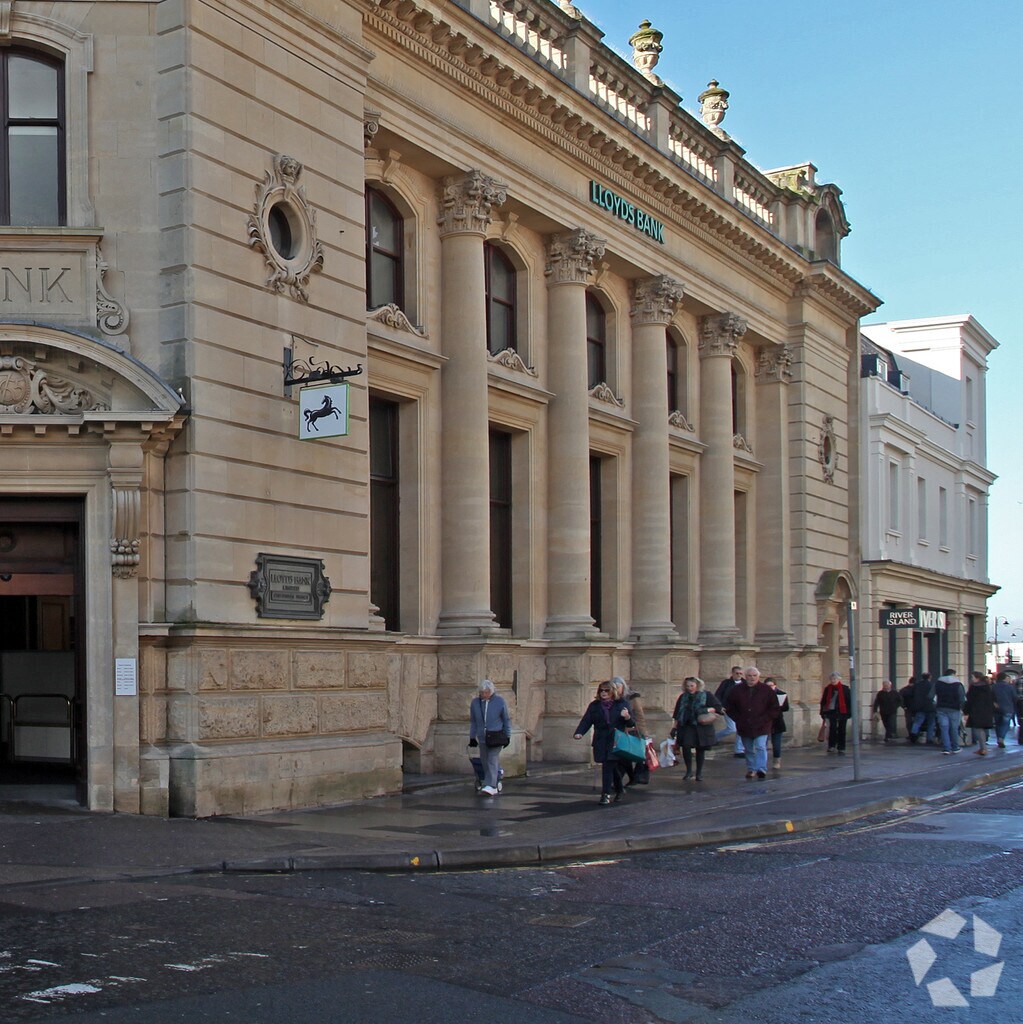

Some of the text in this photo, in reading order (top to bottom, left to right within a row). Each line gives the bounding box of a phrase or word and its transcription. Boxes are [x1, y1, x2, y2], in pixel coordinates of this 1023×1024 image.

[590, 180, 665, 244] LLOYDS BANK
[889, 611, 914, 619] RIVER
[886, 618, 916, 626] ISLAND
